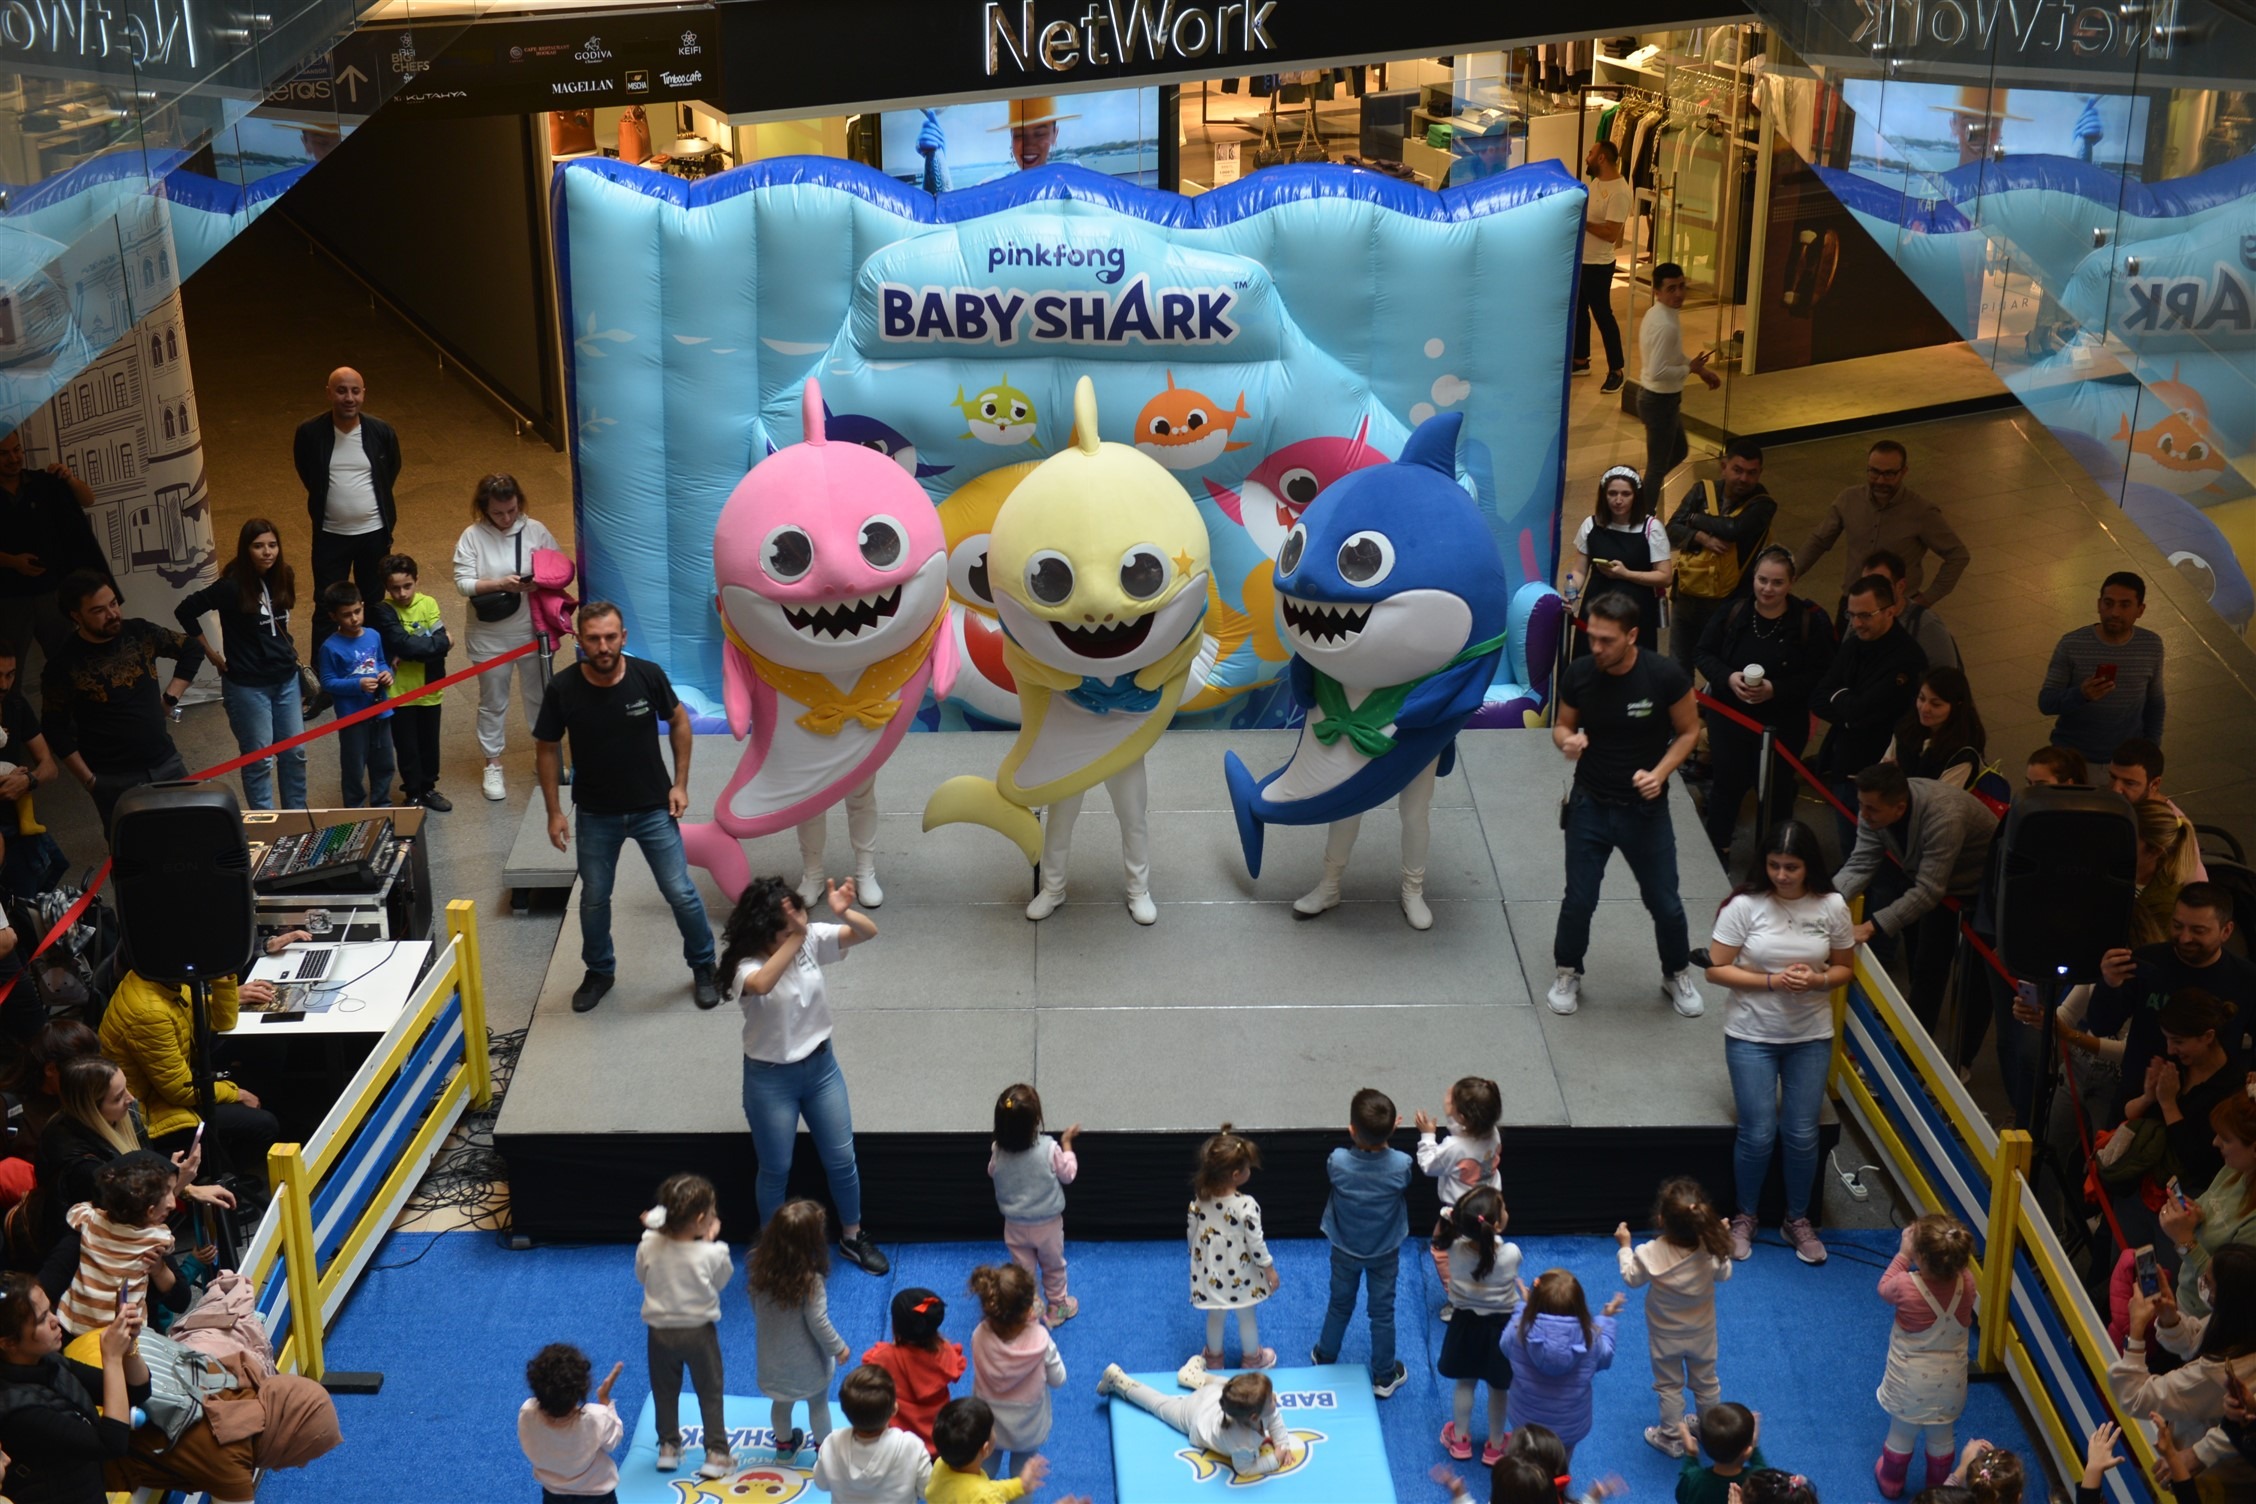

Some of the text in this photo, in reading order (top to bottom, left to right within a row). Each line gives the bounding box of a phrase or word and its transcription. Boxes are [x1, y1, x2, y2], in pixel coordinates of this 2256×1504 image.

[985, 0, 1277, 76] NetWork
[391, 53, 412, 62] BIG
[574, 50, 613, 61] GODIVA
[678, 46, 701, 56] KEIFI
[392, 60, 430, 73] CHEFS
[264, 80, 331, 102] eras
[552, 79, 614, 95] MAGELLAN
[627, 81, 647, 91] MISCHA
[988, 243, 1125, 285] pinkfong
[884, 288, 1024, 342] BABY
[1034, 279, 1234, 342] SHARK
[1276, 1392, 1334, 1408] BAB
